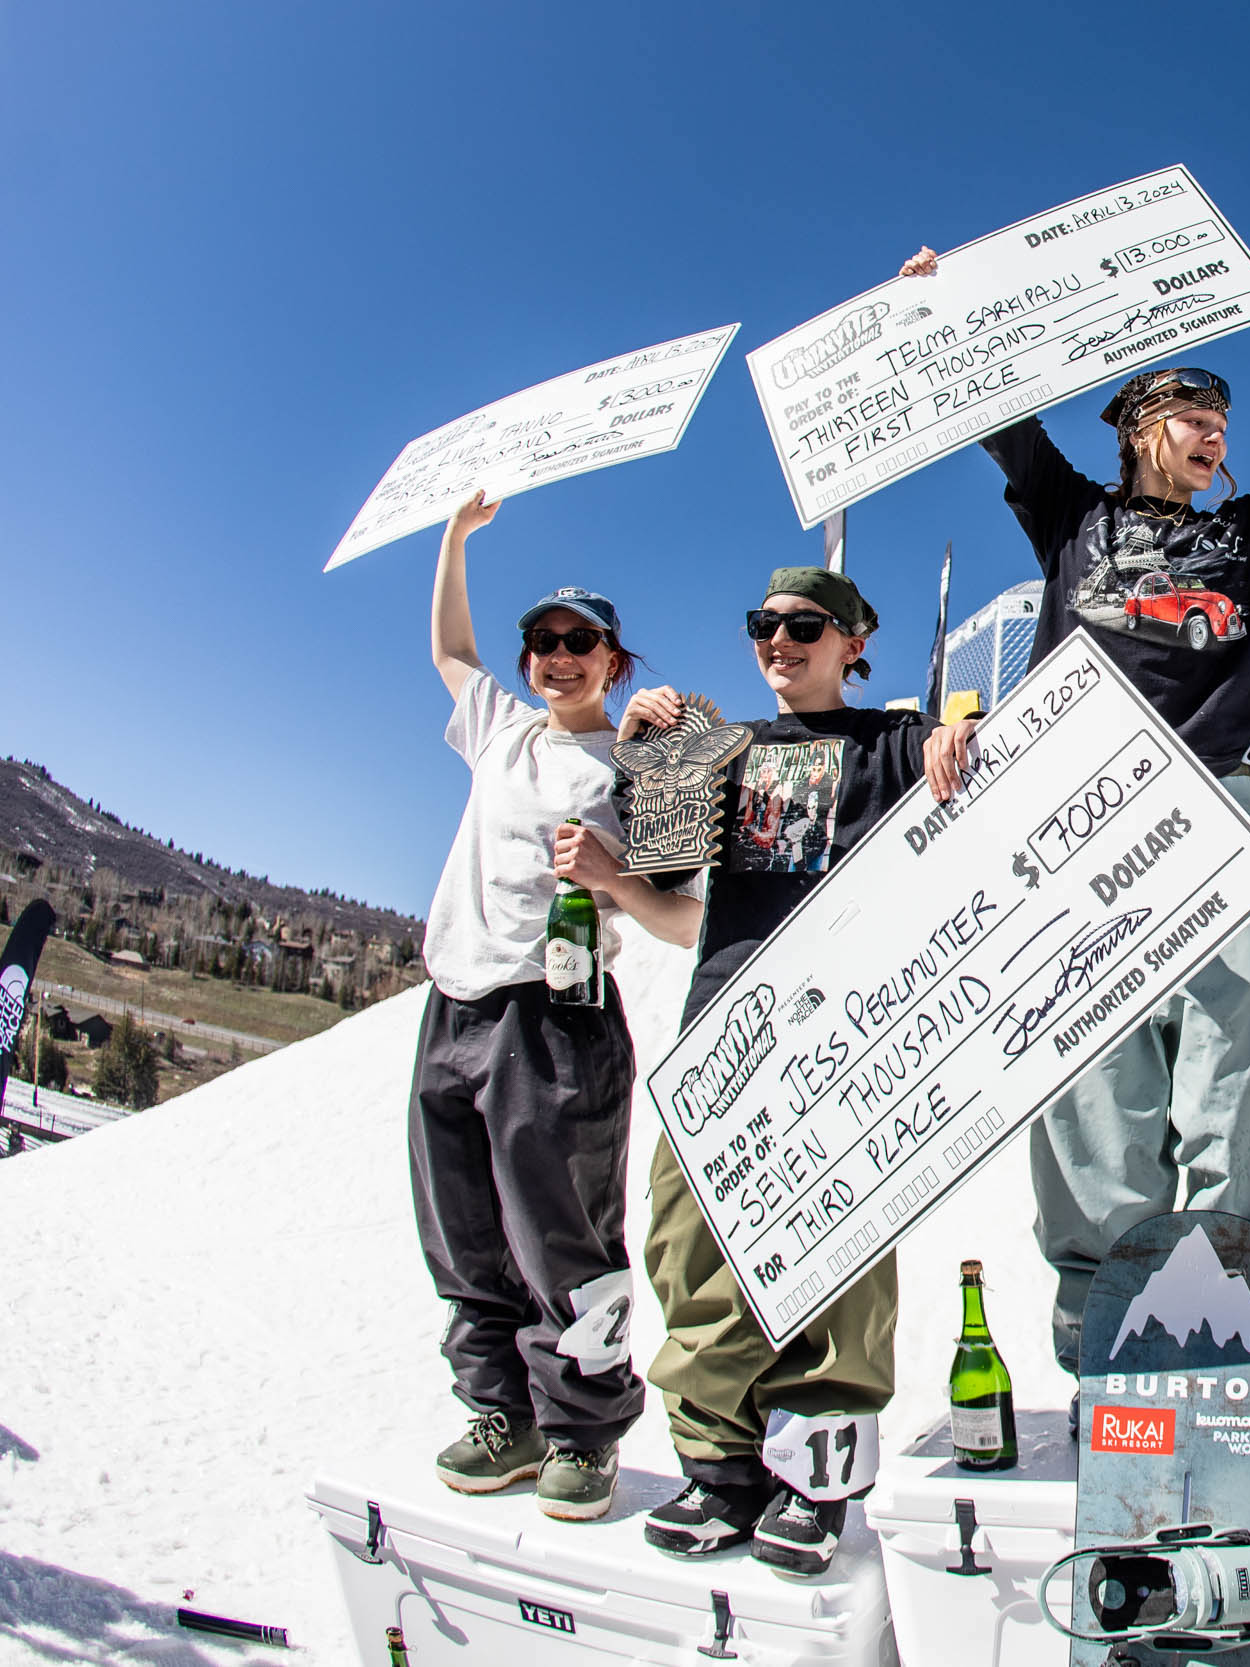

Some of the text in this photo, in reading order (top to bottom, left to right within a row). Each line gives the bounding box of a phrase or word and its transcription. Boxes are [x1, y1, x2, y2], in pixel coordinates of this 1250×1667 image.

[1024, 223, 1074, 249] DATE:
[1072, 206, 1116, 229] APRIL
[1100, 257, 1119, 278] $
[1153, 259, 1230, 296] DOLLARS
[771, 301, 890, 389] UNINVITED
[806, 322, 882, 379] INVITATIONAL
[876, 326, 957, 376] TELMA
[918, 324, 1046, 386] THOUSAND
[1103, 303, 1243, 365] AUTHORIZED SIGNATURE
[585, 366, 621, 384] DATE:
[784, 371, 861, 419] PAY TO THE
[609, 402, 675, 428] DOLLARS
[789, 387, 860, 431] ORDER OF:
[805, 364, 1020, 487] FOR FIRST PLACE
[590, 440, 645, 461] SIGNATURE
[904, 799, 965, 856] DATE:
[959, 734, 1020, 799] APRIL
[632, 801, 708, 846] UNINVITED
[648, 824, 696, 848] INVITATIONAL
[660, 840, 681, 853] 2024
[1012, 851, 1040, 890] $
[1089, 807, 1192, 906] DOLLARS
[1053, 890, 1229, 1057] AUTHORIZED SIGNATURE
[780, 890, 997, 1116] JESS PERLMUTTER
[787, 998, 813, 1026] NORTH
[794, 992, 808, 1009] THE
[796, 1007, 815, 1026] FACE
[2, 1002, 24, 1053] FACE
[672, 983, 775, 1136] UNINVITED
[710, 1020, 777, 1119] INVITATIONAL
[741, 975, 991, 1228] SEVEN THOUSAND
[703, 1106, 773, 1184] PAY TO THE
[715, 1134, 777, 1202] ORDER OF:
[753, 1083, 951, 1289] FOR THIRD PLACE
[604, 1295, 630, 1348] 2
[1102, 1413, 1164, 1441] RUKAI
[1102, 1439, 1163, 1448] SKI RESORT
[1213, 1431, 1250, 1443] PARK
[805, 1421, 858, 1488] 17
[521, 1602, 573, 1632] YETI
